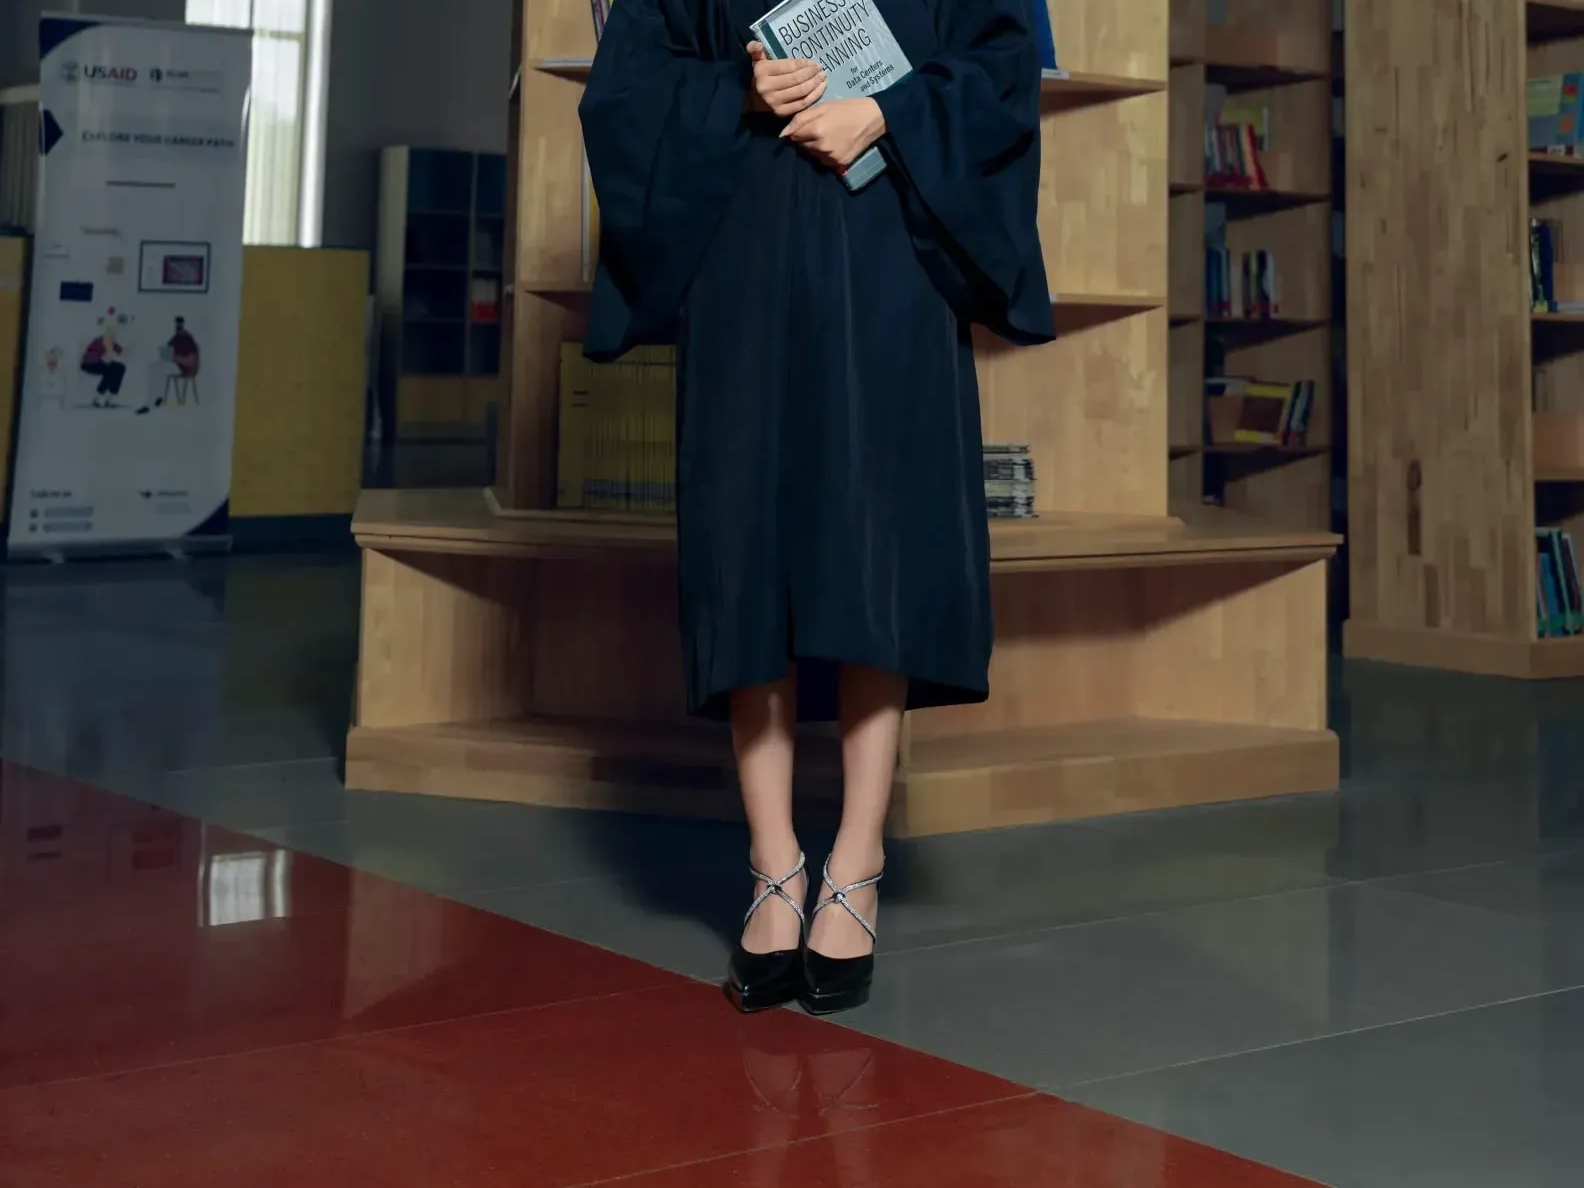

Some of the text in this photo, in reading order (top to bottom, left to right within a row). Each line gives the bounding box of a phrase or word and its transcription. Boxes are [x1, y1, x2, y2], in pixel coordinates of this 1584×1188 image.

[819, 28, 873, 73] ANNING
[84, 65, 138, 82] USAID
[846, 59, 883, 89] Data Centers
[850, 66, 859, 75] for
[860, 64, 894, 92] and Systems
